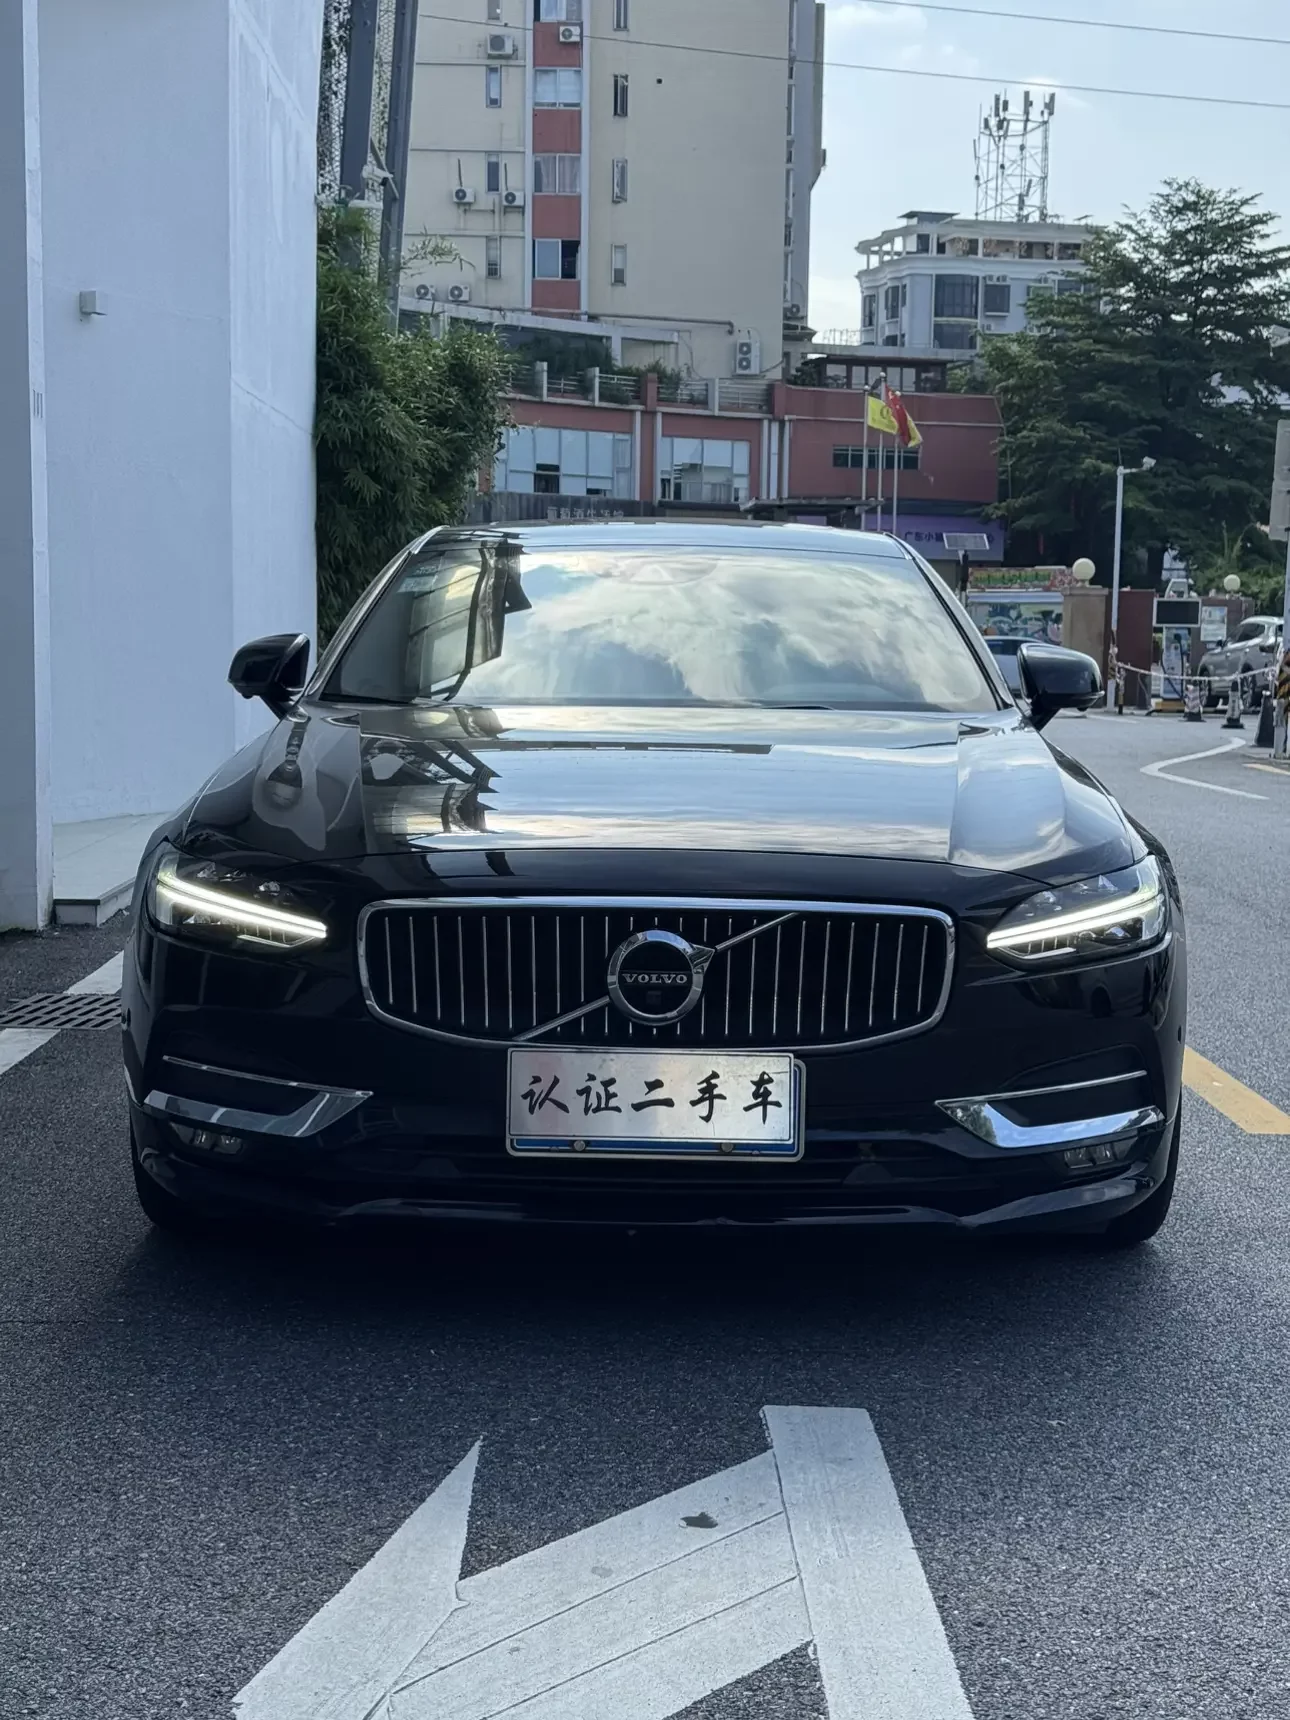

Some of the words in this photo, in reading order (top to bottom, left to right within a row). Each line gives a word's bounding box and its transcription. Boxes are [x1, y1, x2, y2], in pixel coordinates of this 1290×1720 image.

[622, 973, 688, 984] VOLVO
[520, 1070, 783, 1125] 认证二手车
